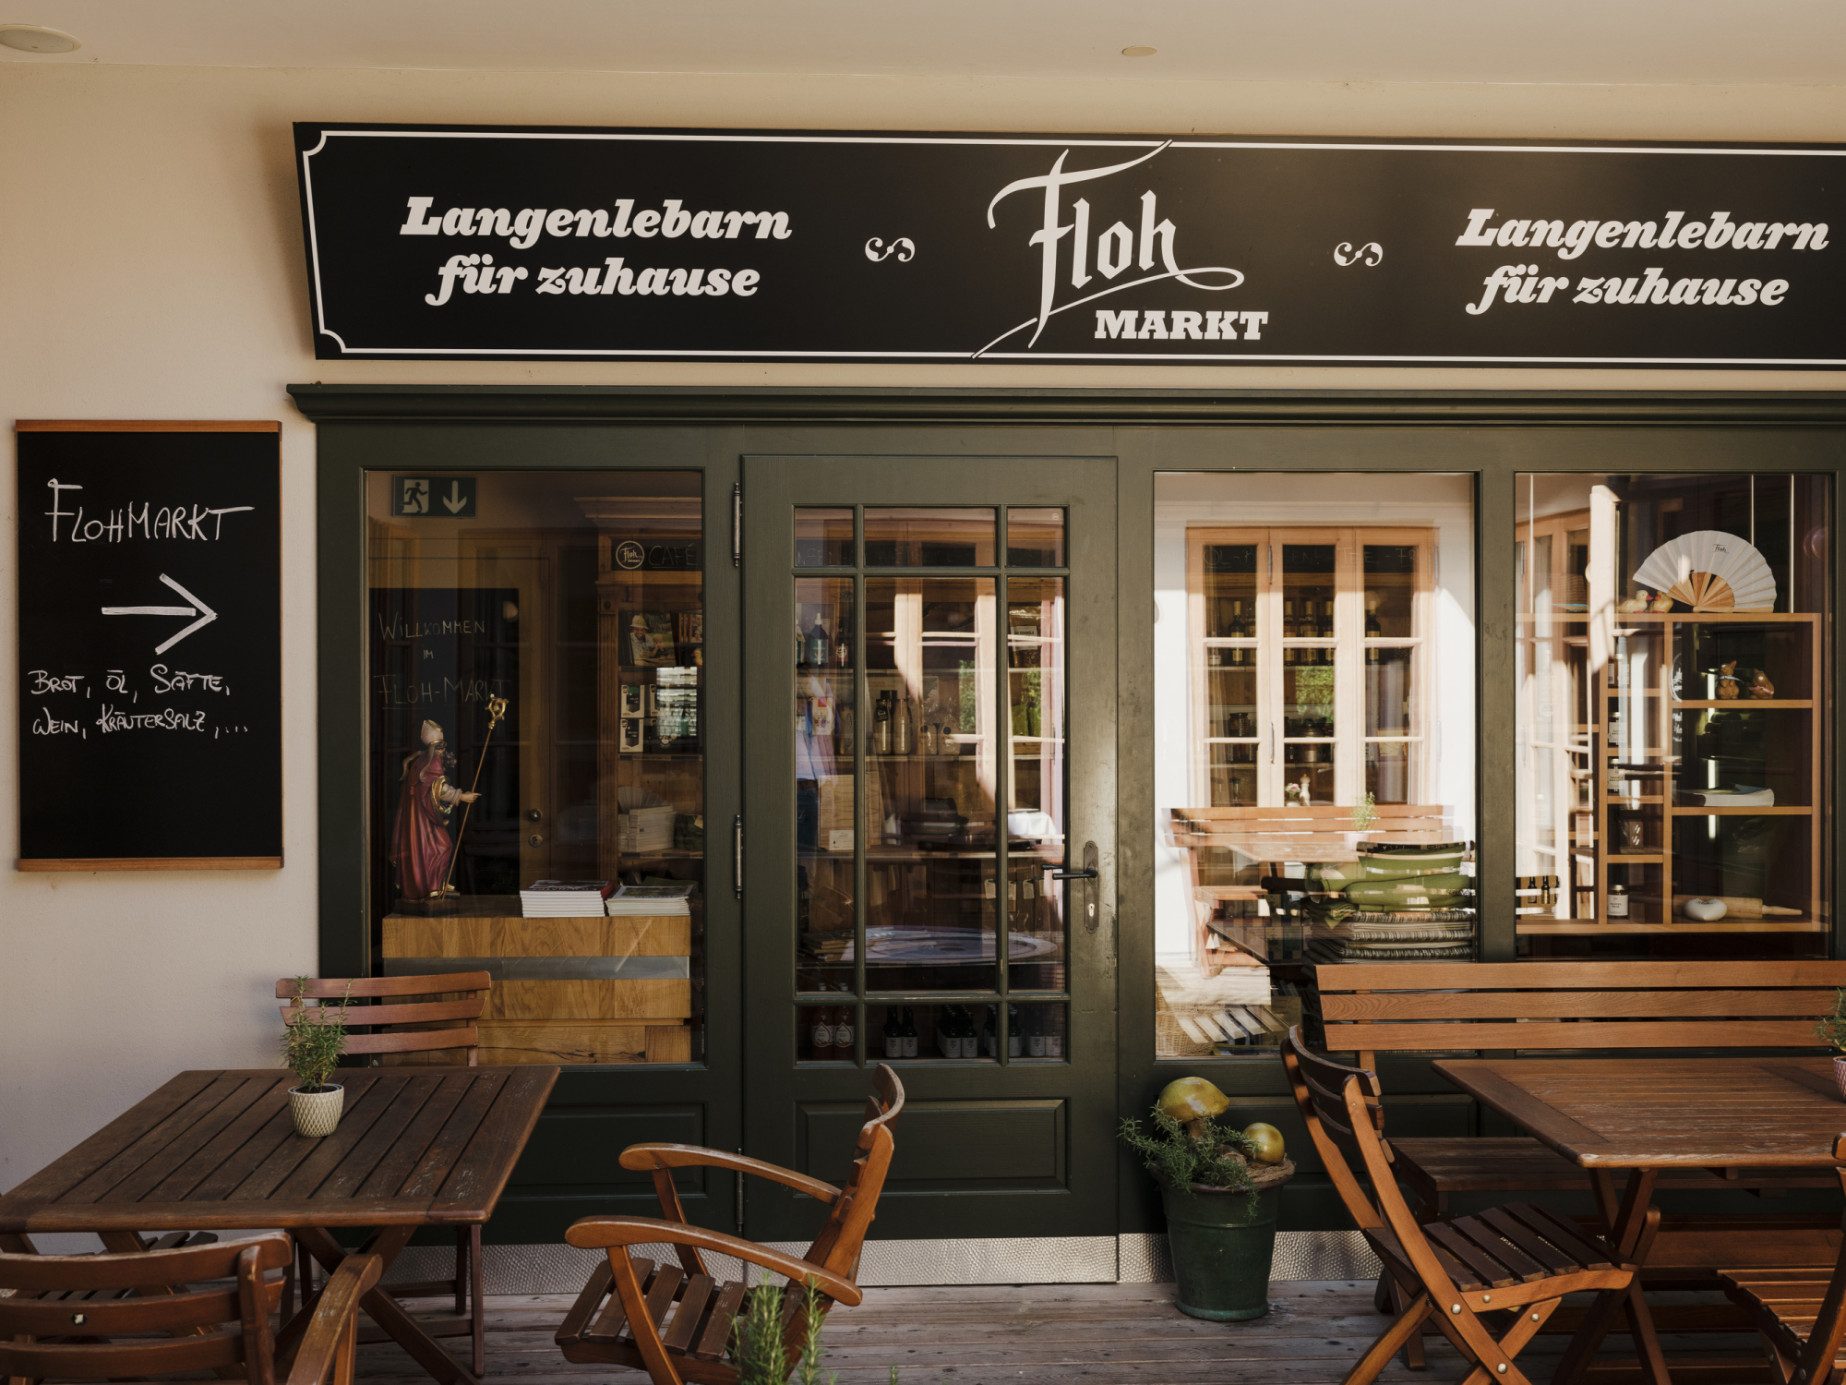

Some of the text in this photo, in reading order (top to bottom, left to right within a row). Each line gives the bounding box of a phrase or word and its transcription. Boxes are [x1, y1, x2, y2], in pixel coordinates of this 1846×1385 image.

[400, 196, 793, 250] Langenlebarn
[986, 140, 1245, 350] Floh
[1455, 208, 1830, 261] Langenlebarn
[425, 253, 760, 307] für zuhause
[1465, 263, 1790, 316] für zuhause
[1094, 310, 1269, 341] MARKT
[45, 477, 255, 543] FLOHMARKT
